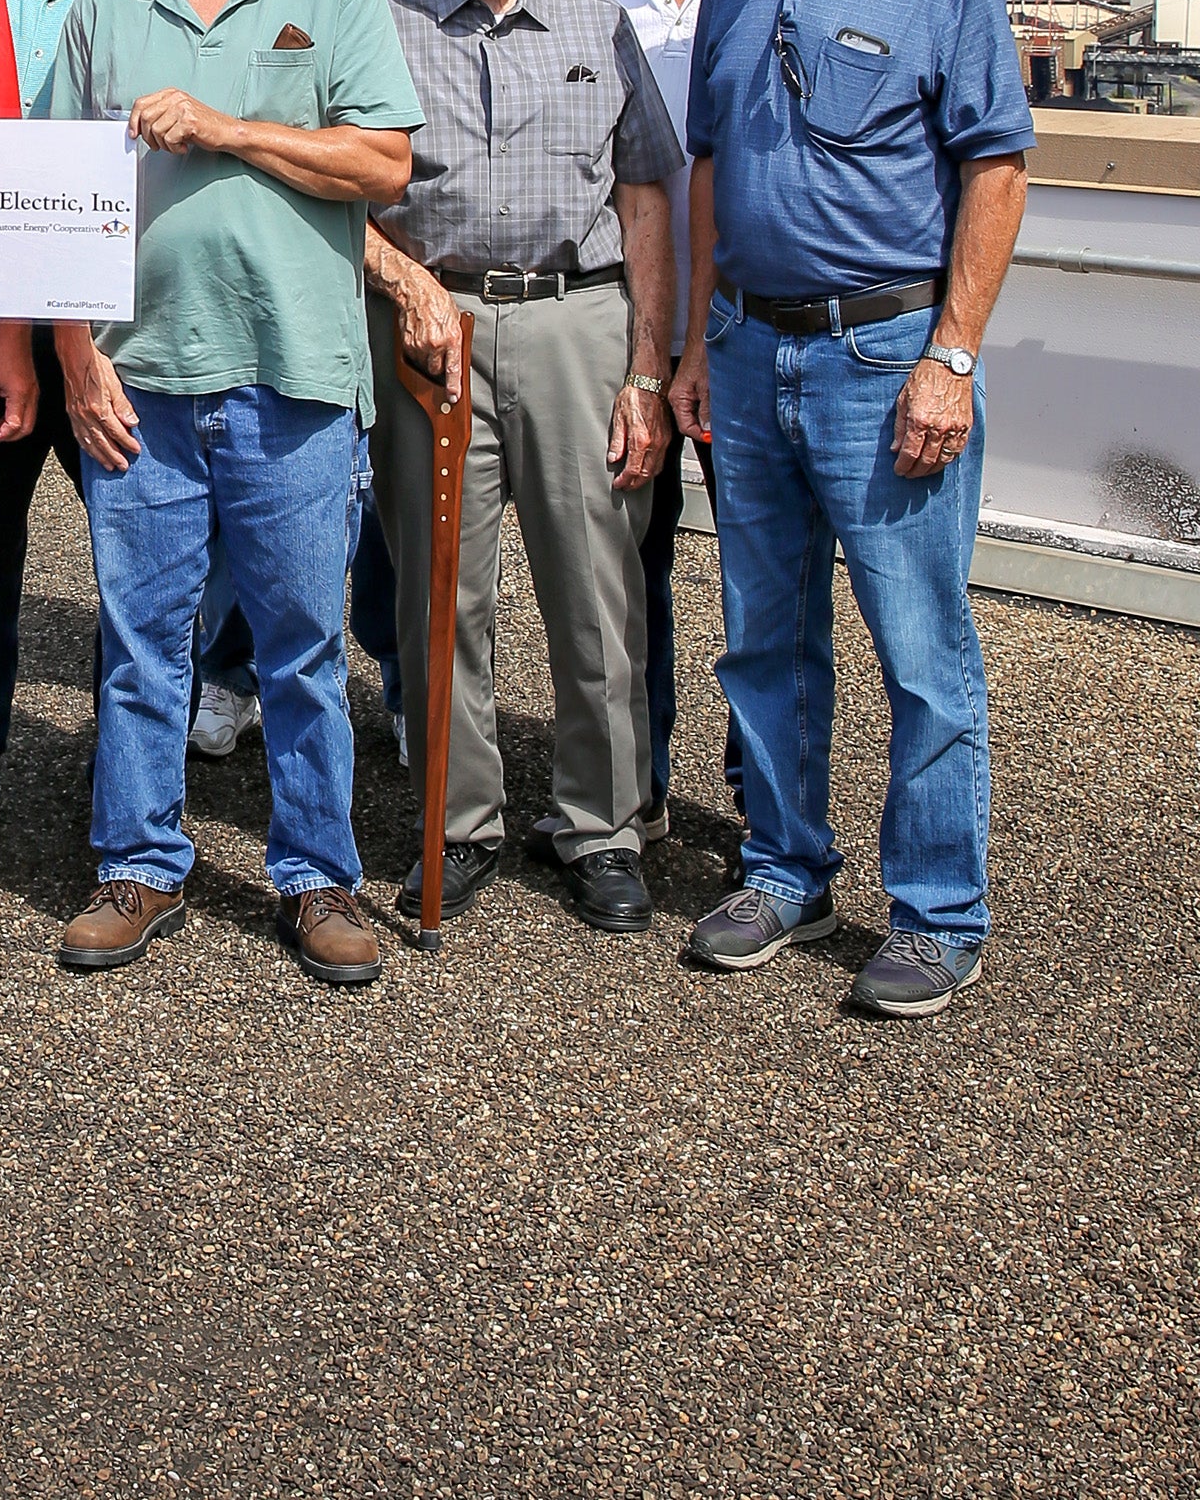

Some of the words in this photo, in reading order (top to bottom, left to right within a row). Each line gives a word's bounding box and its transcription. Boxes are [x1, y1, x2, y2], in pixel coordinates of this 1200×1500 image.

[0, 191, 83, 214] Electric,
[91, 193, 131, 212] Inc.
[53, 223, 100, 235] Cooperative
[46, 301, 117, 310] #CardinalPlantTour
